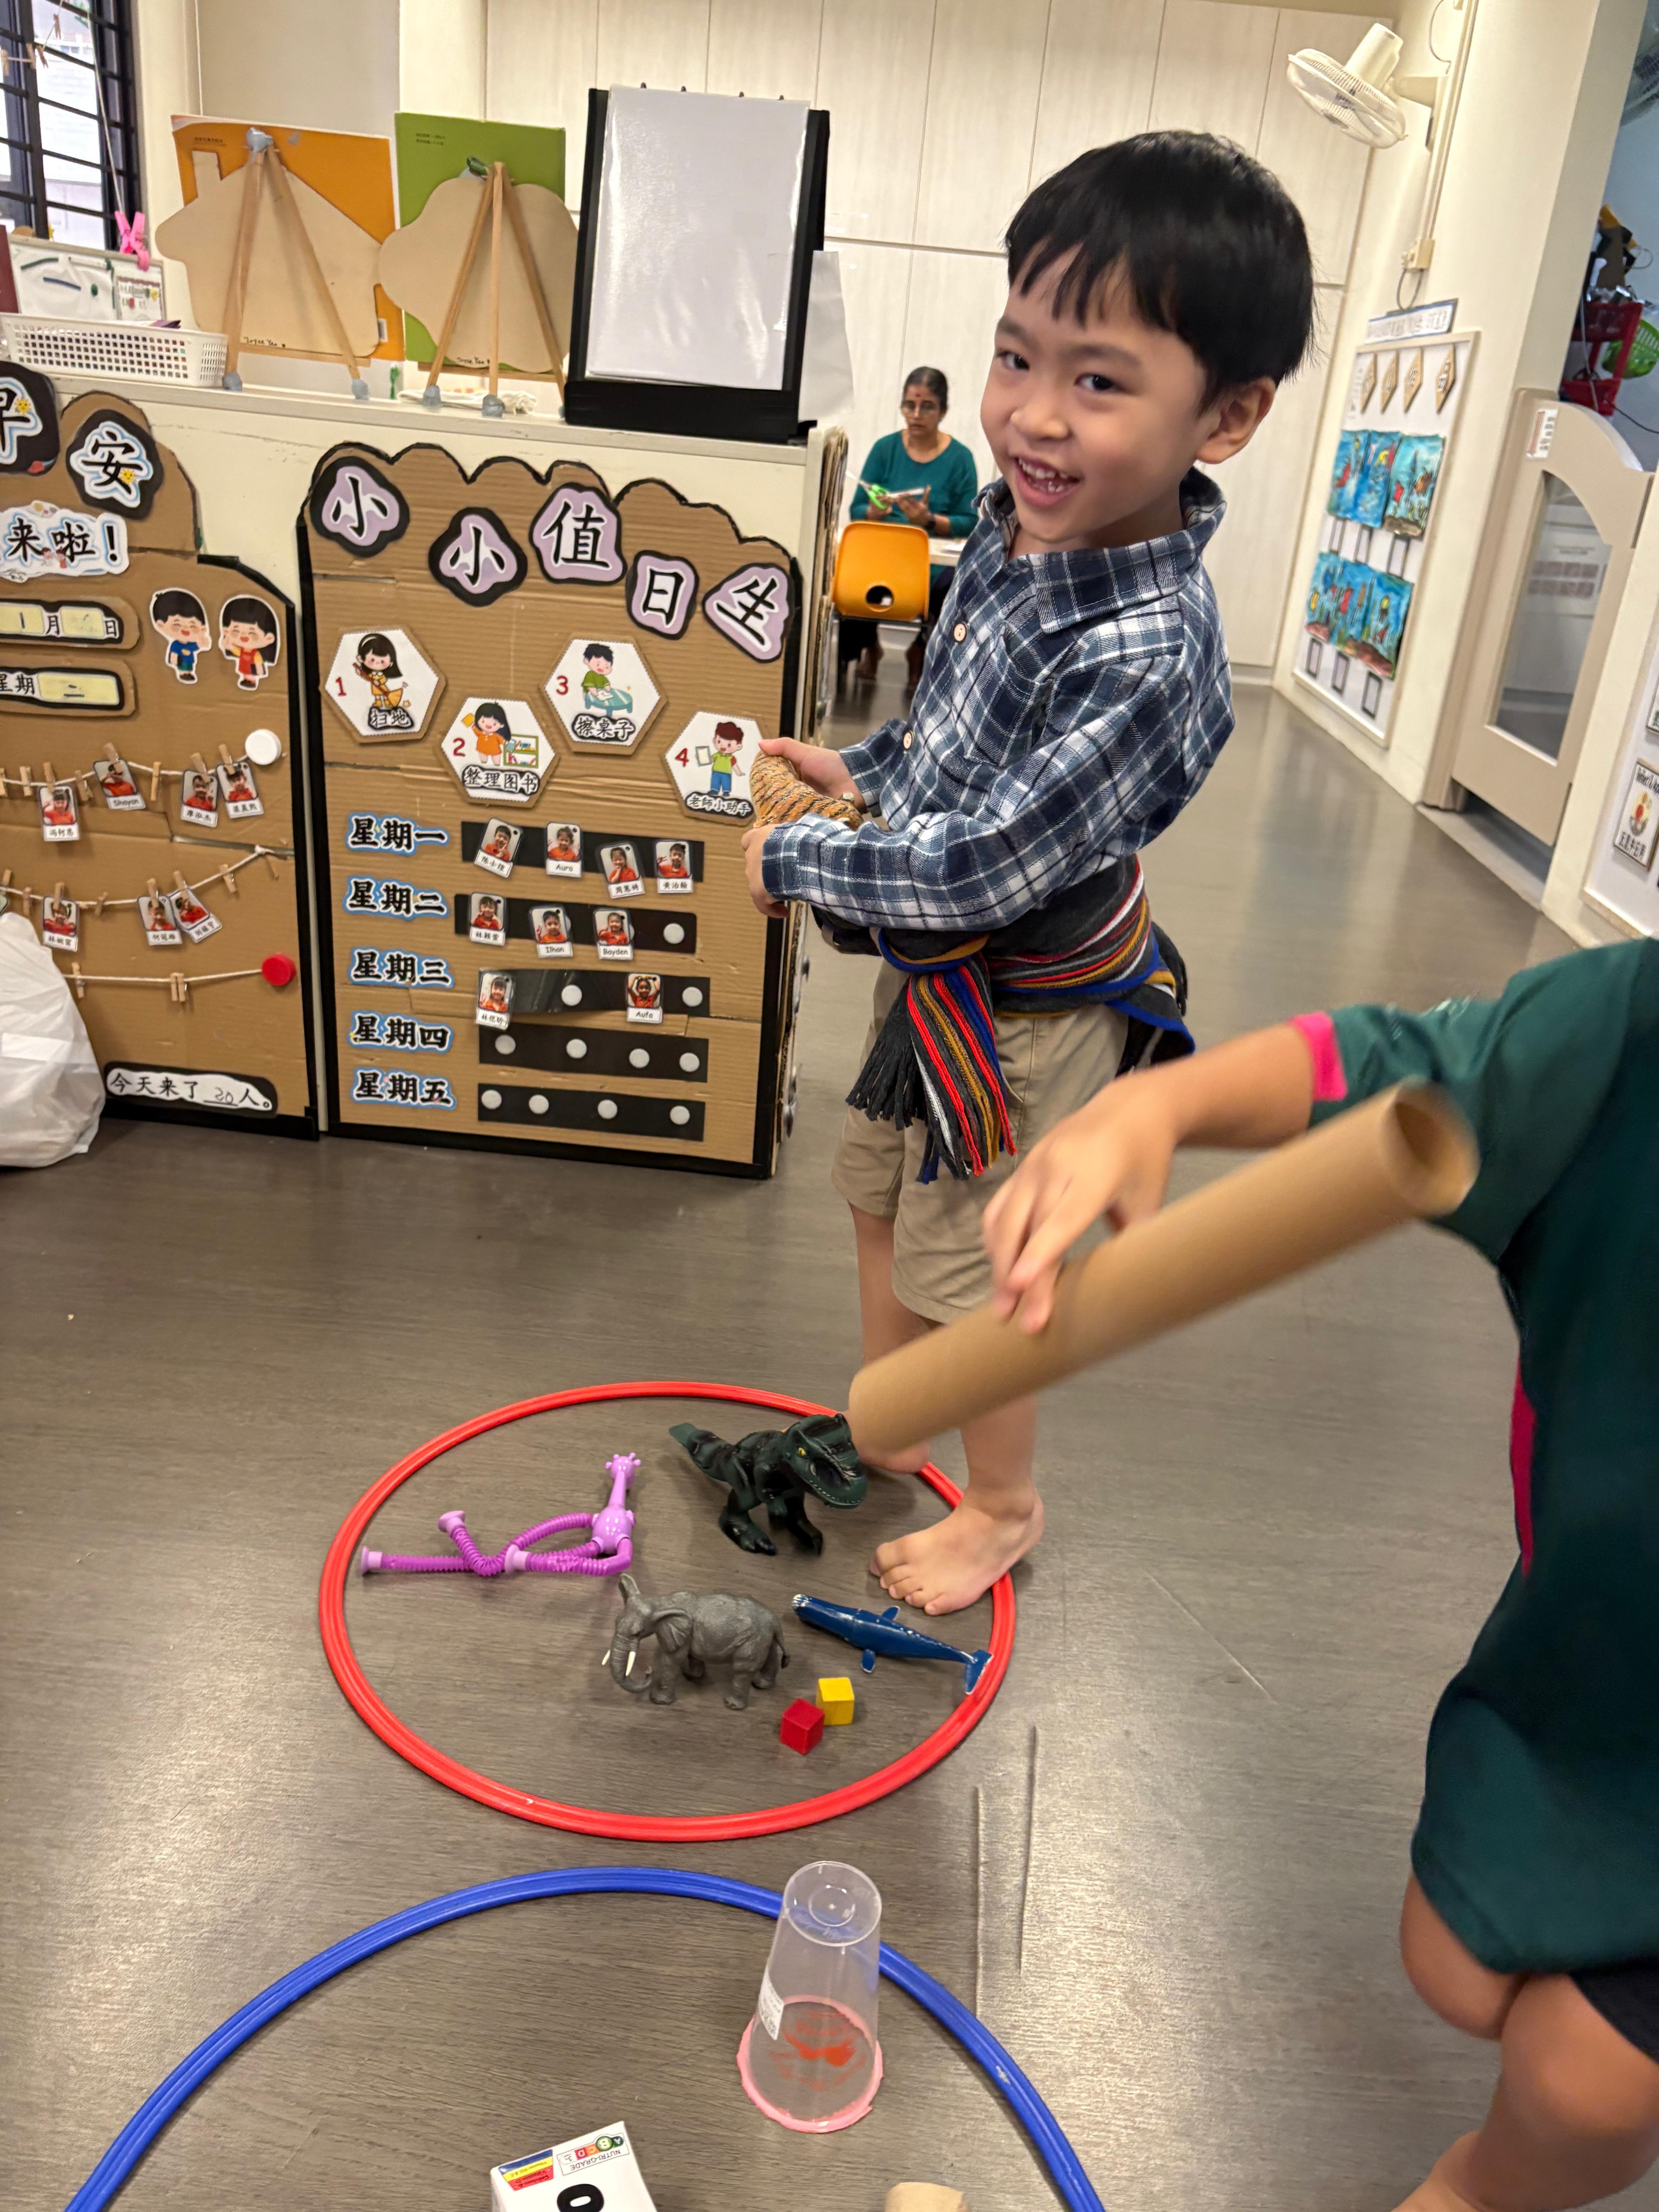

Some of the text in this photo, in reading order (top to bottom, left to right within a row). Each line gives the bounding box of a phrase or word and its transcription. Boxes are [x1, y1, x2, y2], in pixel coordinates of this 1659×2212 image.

[332, 476, 778, 645] 小小值日生
[336, 677, 346, 696] 1
[556, 676, 569, 695] 3
[371, 709, 409, 728] 扫地
[576, 717, 632, 739] 擦桌子
[452, 738, 466, 757] 2
[675, 748, 689, 767] 4
[464, 768, 537, 792] 整理图书
[350, 817, 446, 850] 星期一
[349, 880, 445, 915] 星期二
[353, 951, 450, 983] 星期三
[353, 1015, 449, 1049] 星期四
[356, 1072, 452, 1105] 星期五
[570, 2149, 621, 2171] NUTRI-GRADE
